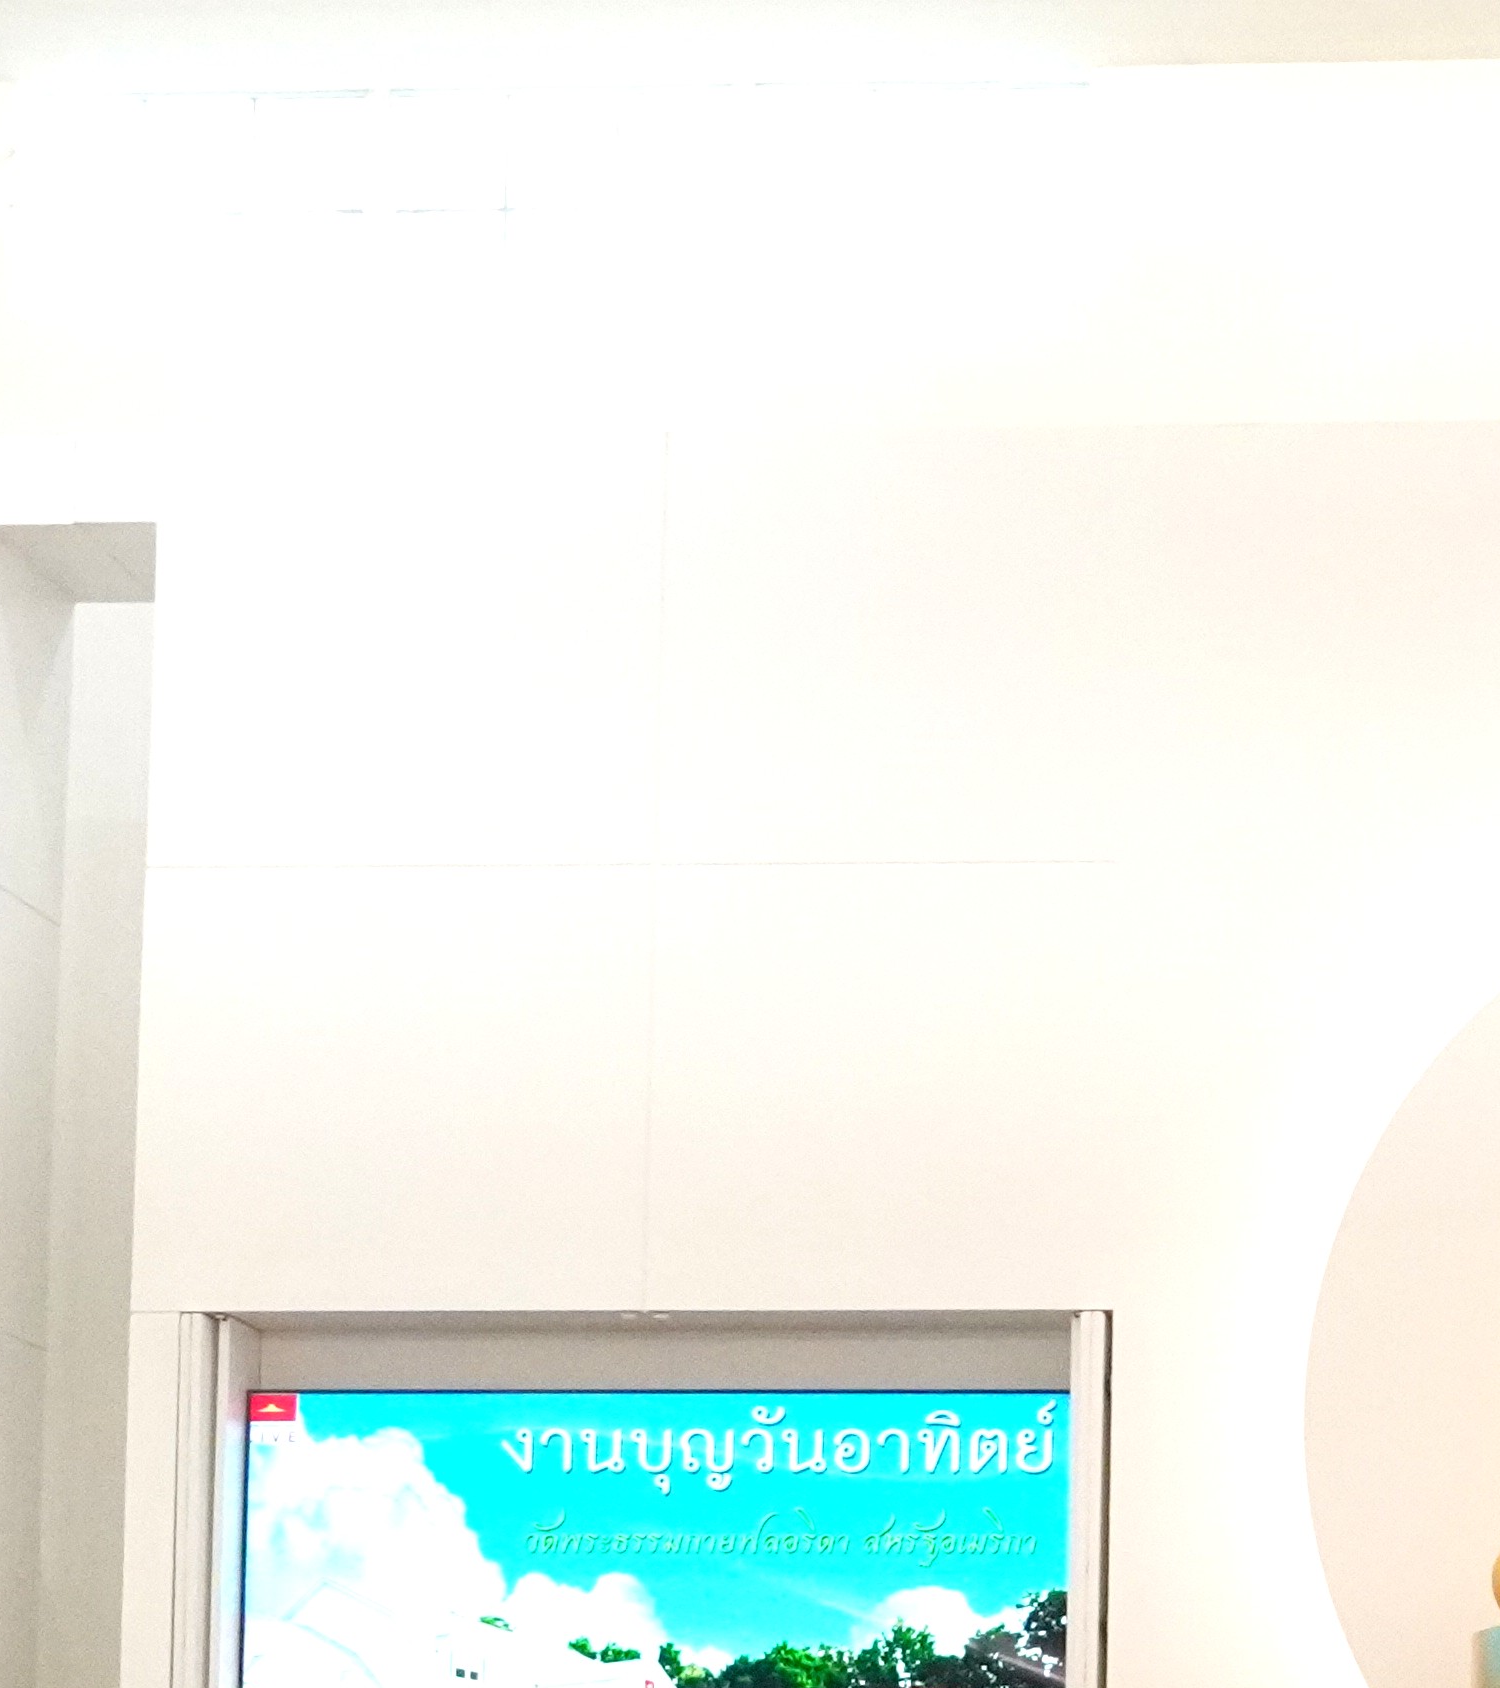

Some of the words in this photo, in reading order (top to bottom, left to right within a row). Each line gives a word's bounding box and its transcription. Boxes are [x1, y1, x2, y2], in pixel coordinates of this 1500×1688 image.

[501, 1399, 1057, 1496] งานบุญวันอาทิตย์
[863, 1507, 1038, 1568] สหรัฐอเมริกา
